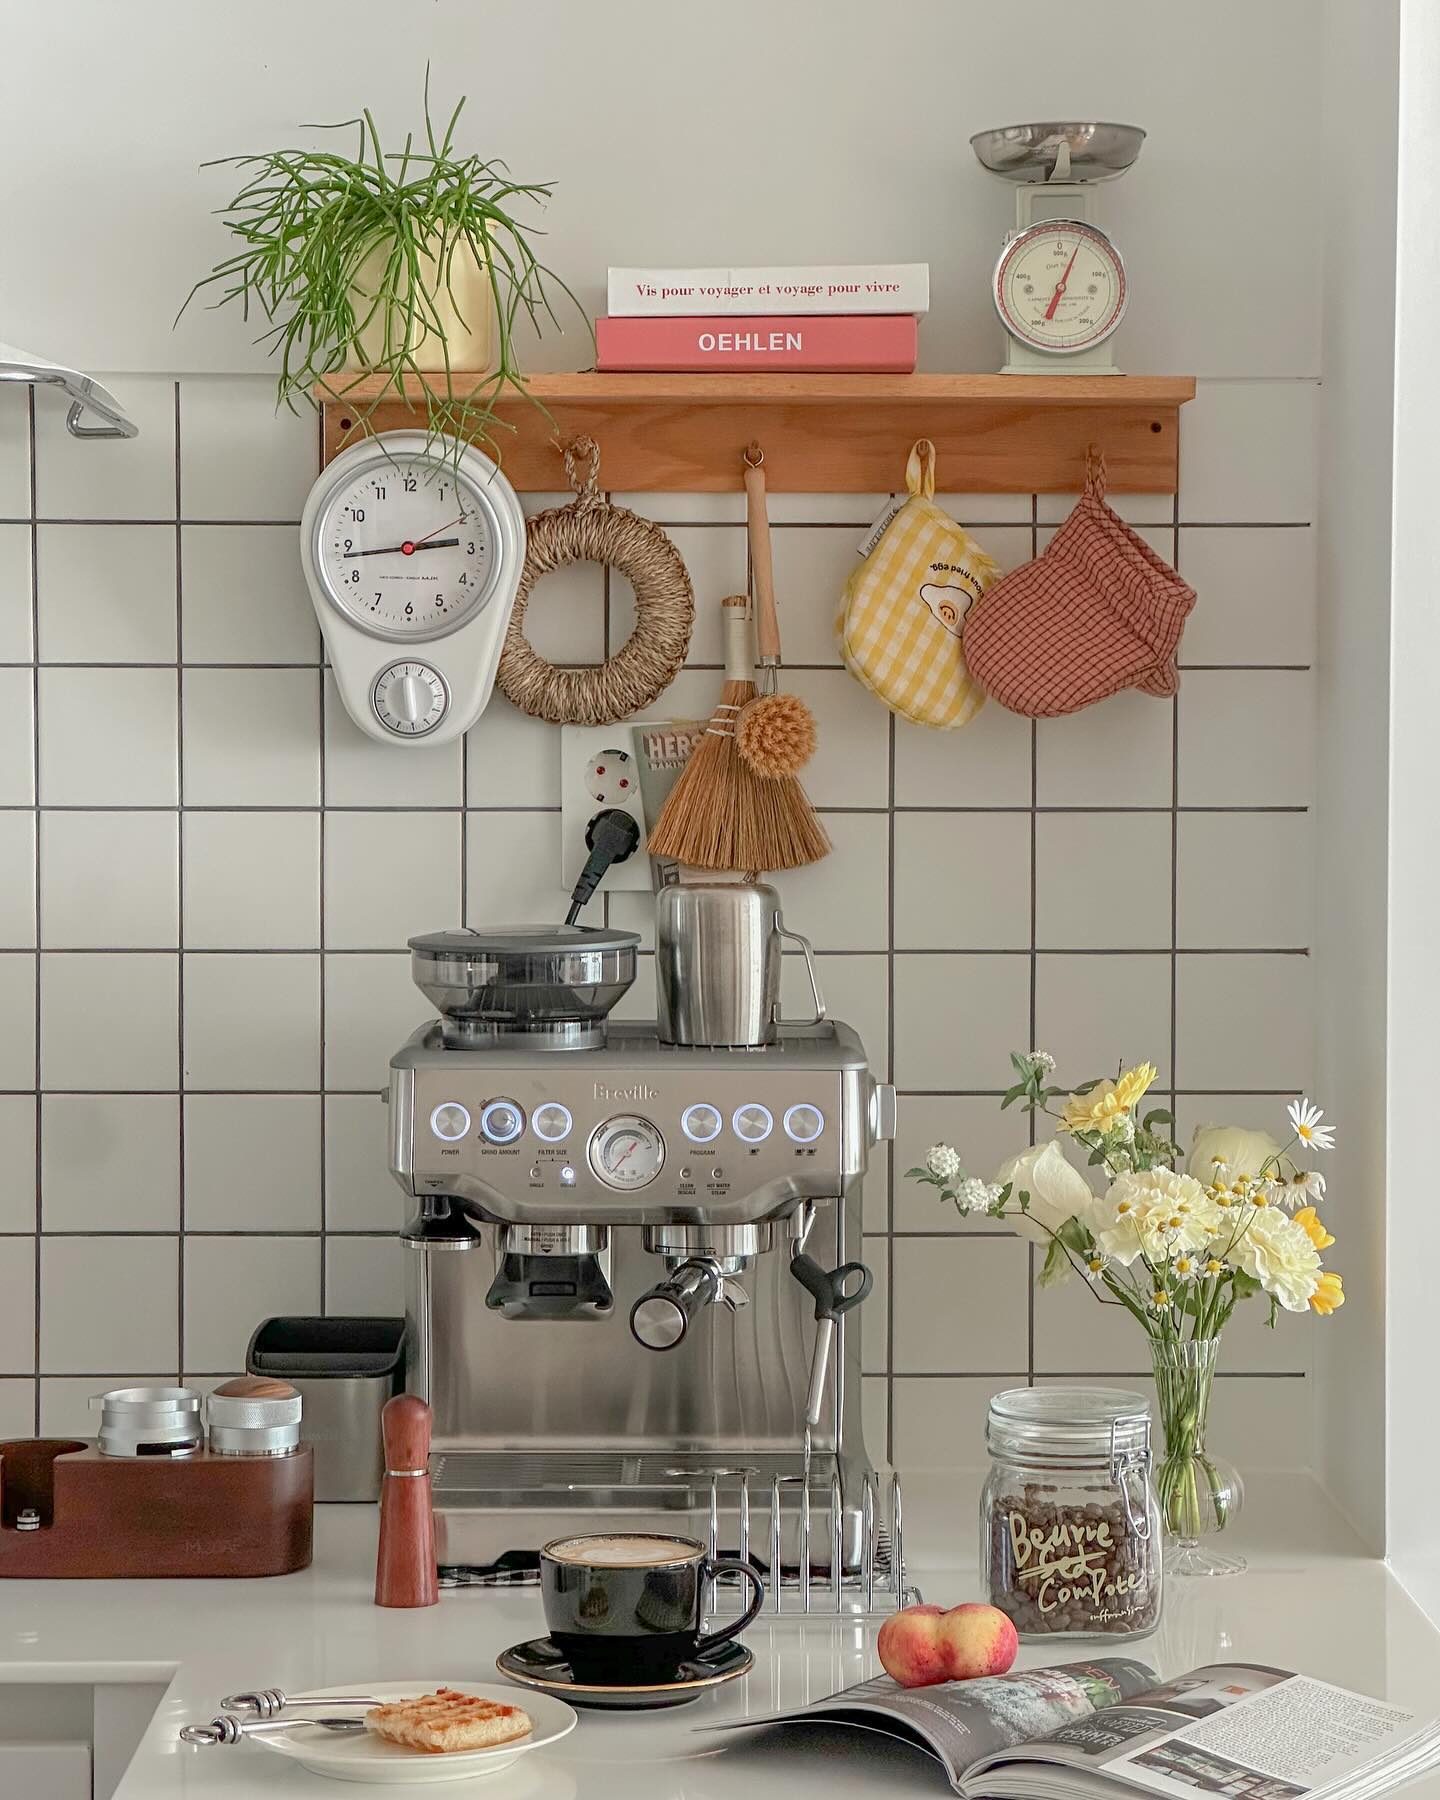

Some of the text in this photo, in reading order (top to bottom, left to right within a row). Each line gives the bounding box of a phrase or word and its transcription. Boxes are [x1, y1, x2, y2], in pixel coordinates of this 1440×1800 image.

[1056, 241, 1063, 250] 0
[636, 281, 900, 298] Vis pour voyager et voyage pour vivre
[698, 333, 803, 352] OEHLEN
[403, 479, 417, 492] 12
[375, 487, 386, 500] 11
[438, 488, 445, 501] 1
[351, 509, 365, 523] 10
[344, 539, 353, 552] 9
[467, 542, 475, 555] 3
[352, 570, 360, 583] 8
[950, 564, 970, 579] fried
[458, 572, 467, 585] 4
[969, 575, 985, 598] cious
[374, 593, 382, 606] 7
[435, 594, 444, 607] 5
[404, 602, 413, 615] 6
[593, 1082, 658, 1100] Breville
